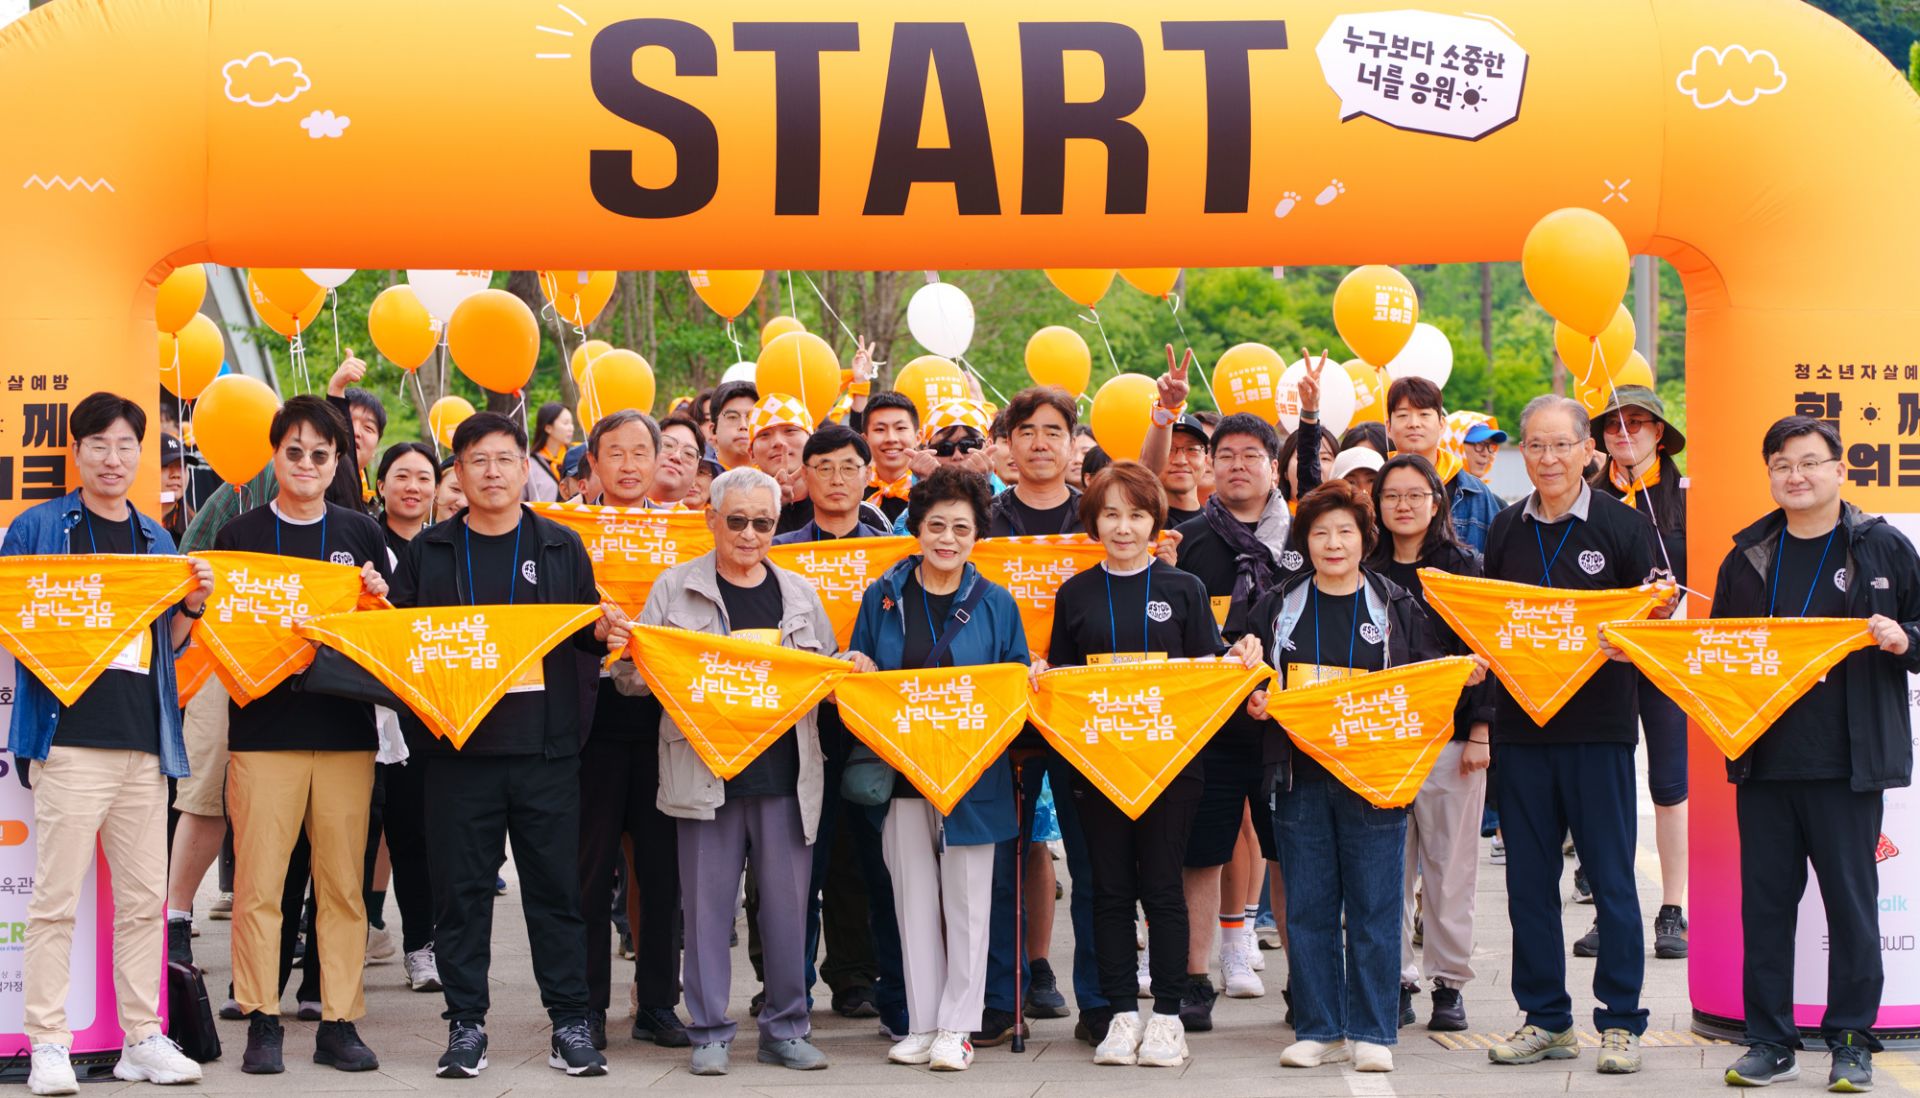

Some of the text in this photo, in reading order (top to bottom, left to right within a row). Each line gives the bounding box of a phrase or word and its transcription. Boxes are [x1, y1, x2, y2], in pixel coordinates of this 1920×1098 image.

[1342, 25, 1506, 79] 누구보다 소중한
[1357, 63, 1456, 111] 너를 응원
[589, 17, 1289, 219] START
[0, 374, 69, 391] 살예방
[22, 403, 68, 448] 께
[596, 514, 670, 538] 청소년을
[795, 550, 870, 576] 청소년을
[1002, 556, 1078, 584] 청소년을
[26, 572, 104, 600] 청소년을
[227, 568, 303, 601] 청소년을
[1504, 599, 1578, 624] 청소년을
[412, 614, 489, 642] 청소년을
[1692, 625, 1771, 649] 청소년을
[698, 651, 773, 683] 청소년을
[899, 674, 976, 704] 청소년을
[1088, 686, 1164, 715] 청소년을
[1334, 684, 1410, 716] 청소년을
